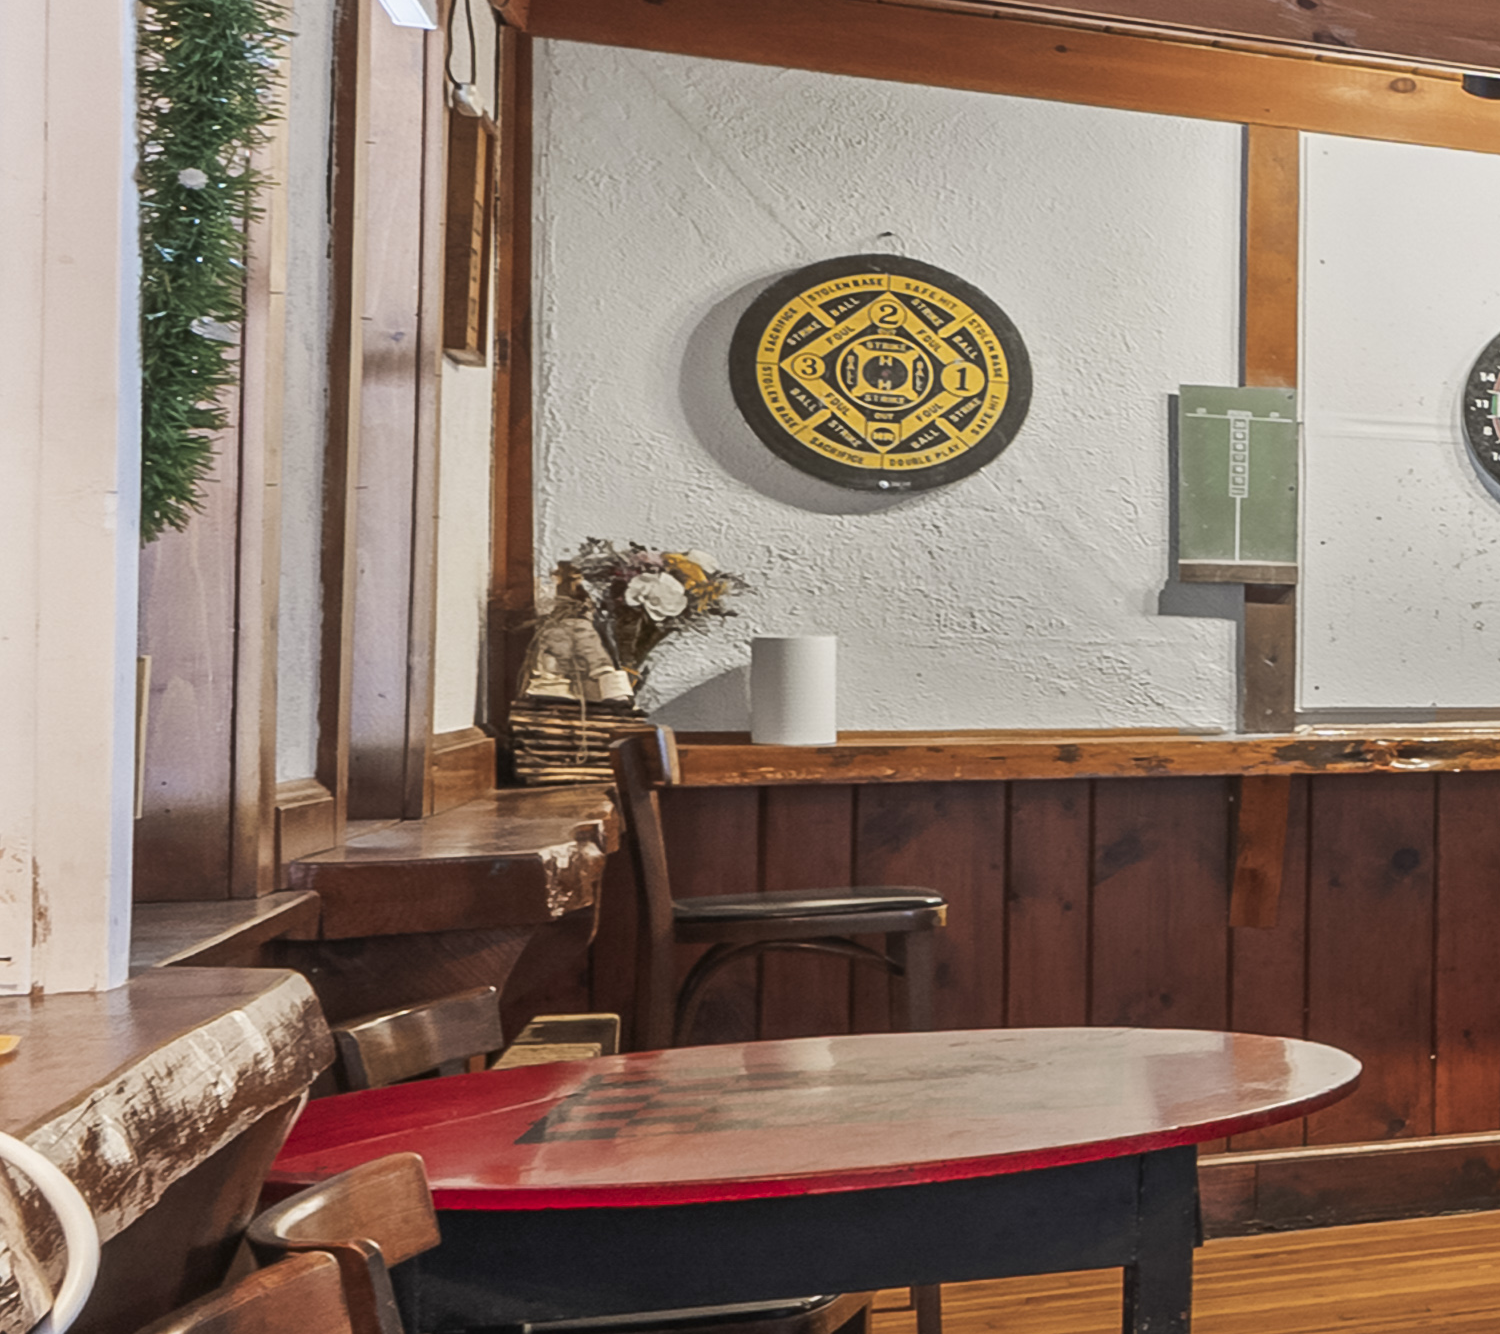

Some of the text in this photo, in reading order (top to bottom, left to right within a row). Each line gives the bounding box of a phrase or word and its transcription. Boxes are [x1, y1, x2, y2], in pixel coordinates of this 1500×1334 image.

[806, 278, 883, 302] STOLEN BASE
[904, 283, 958, 310] SAFE HIT
[829, 297, 860, 317] BALL
[878, 303, 898, 325] 2
[911, 298, 945, 327] STRIKE
[764, 307, 798, 352] SACRIFICE
[786, 320, 822, 345] STRIKE
[825, 325, 856, 346] FOUL
[916, 329, 942, 353] FOUL
[866, 341, 907, 351] STRIKE
[952, 335, 978, 360] BALL
[968, 318, 1003, 378] STOLEN BASE
[801, 357, 818, 376] 3
[1480, 373, 1496, 382] 14
[955, 367, 970, 391] 1
[762, 366, 799, 428] STOLEN BASE
[789, 388, 817, 412] BALL
[824, 392, 850, 416] FOUL
[864, 394, 905, 404] STRIKE
[1476, 400, 1489, 408] 11
[915, 403, 944, 422] FOUL
[949, 397, 983, 422] STRIKE
[971, 394, 1000, 435] SAFE HIT
[827, 419, 863, 447] STRIKE
[911, 429, 941, 449] BALL
[1483, 427, 1492, 436] 8
[809, 437, 864, 464] SACRIFICE
[889, 444, 960, 467] DOUBLE PLAY
